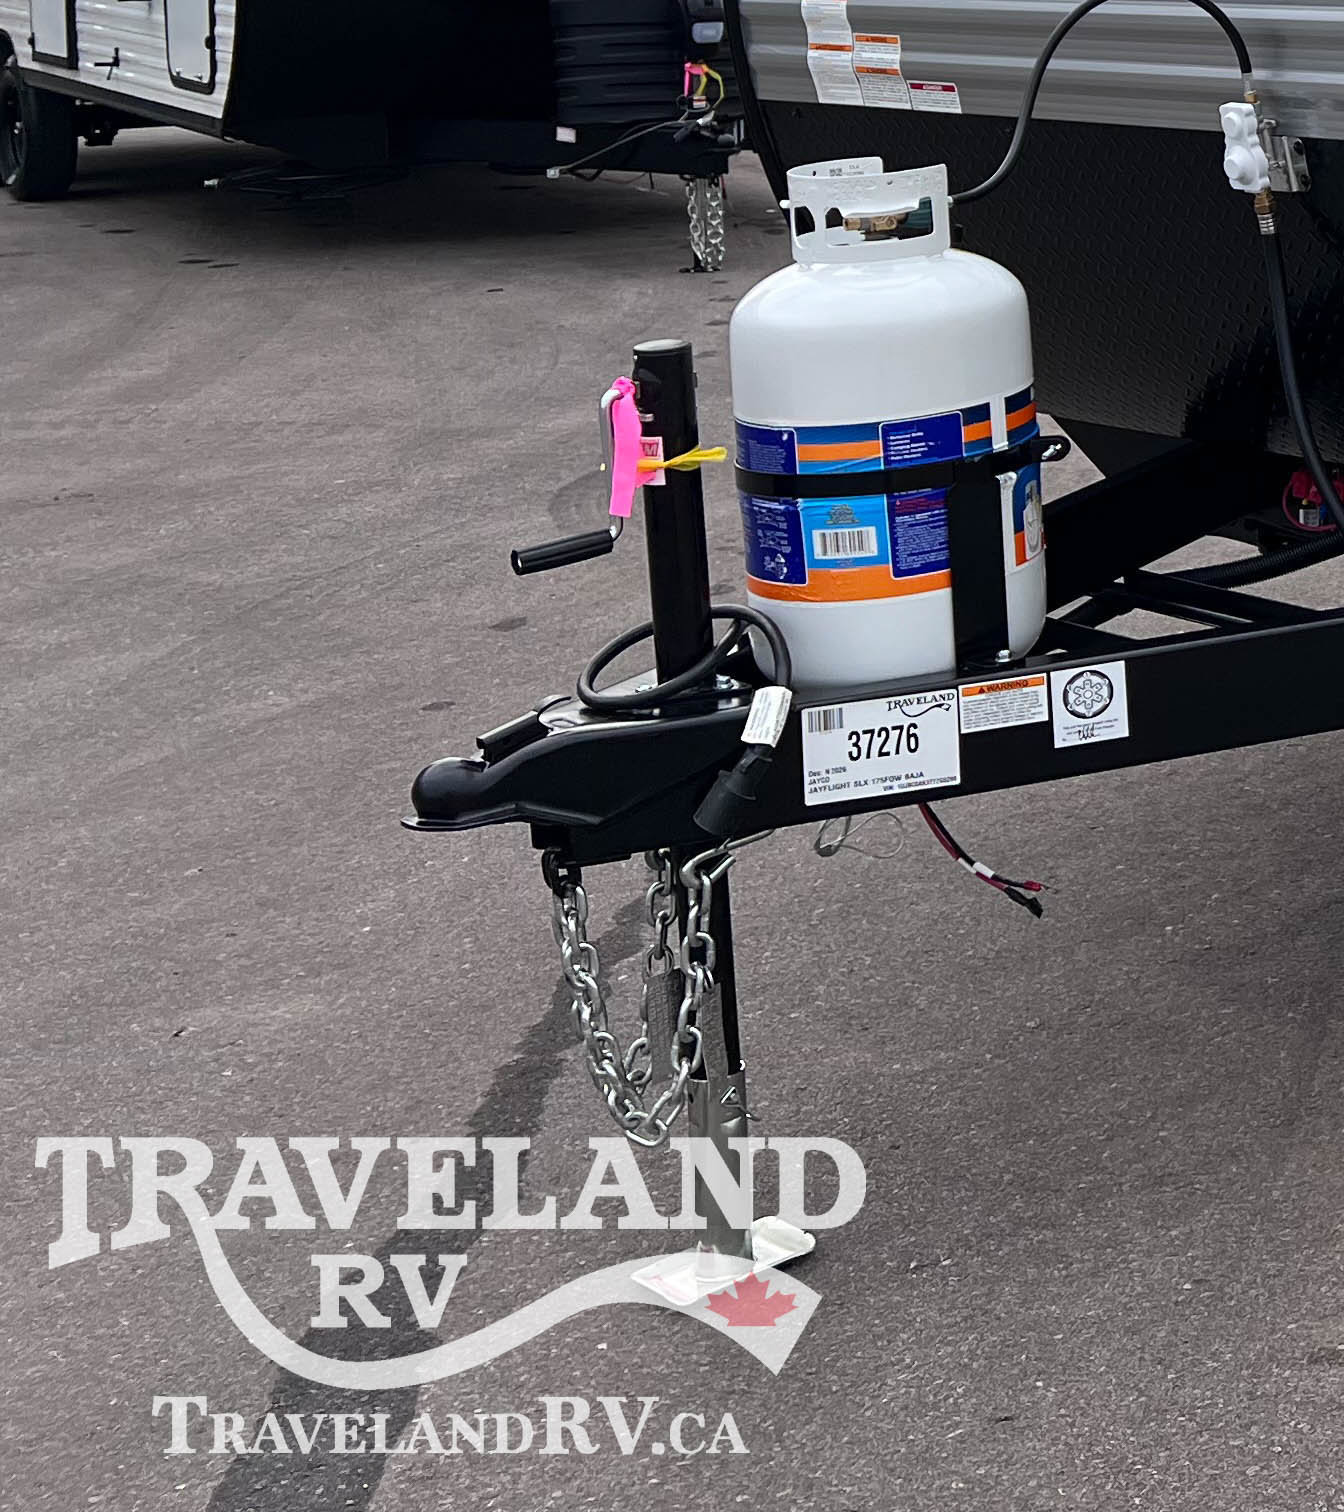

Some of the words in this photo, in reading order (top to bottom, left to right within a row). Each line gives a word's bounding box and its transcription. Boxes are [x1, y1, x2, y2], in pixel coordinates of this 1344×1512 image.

[986, 679, 1029, 692] WARNING
[885, 692, 955, 712] TRAVELAND
[847, 722, 919, 762] 37276
[808, 776, 830, 786] JAYCO
[808, 781, 851, 794] JAYFLIGHT
[853, 780, 869, 788] SLX
